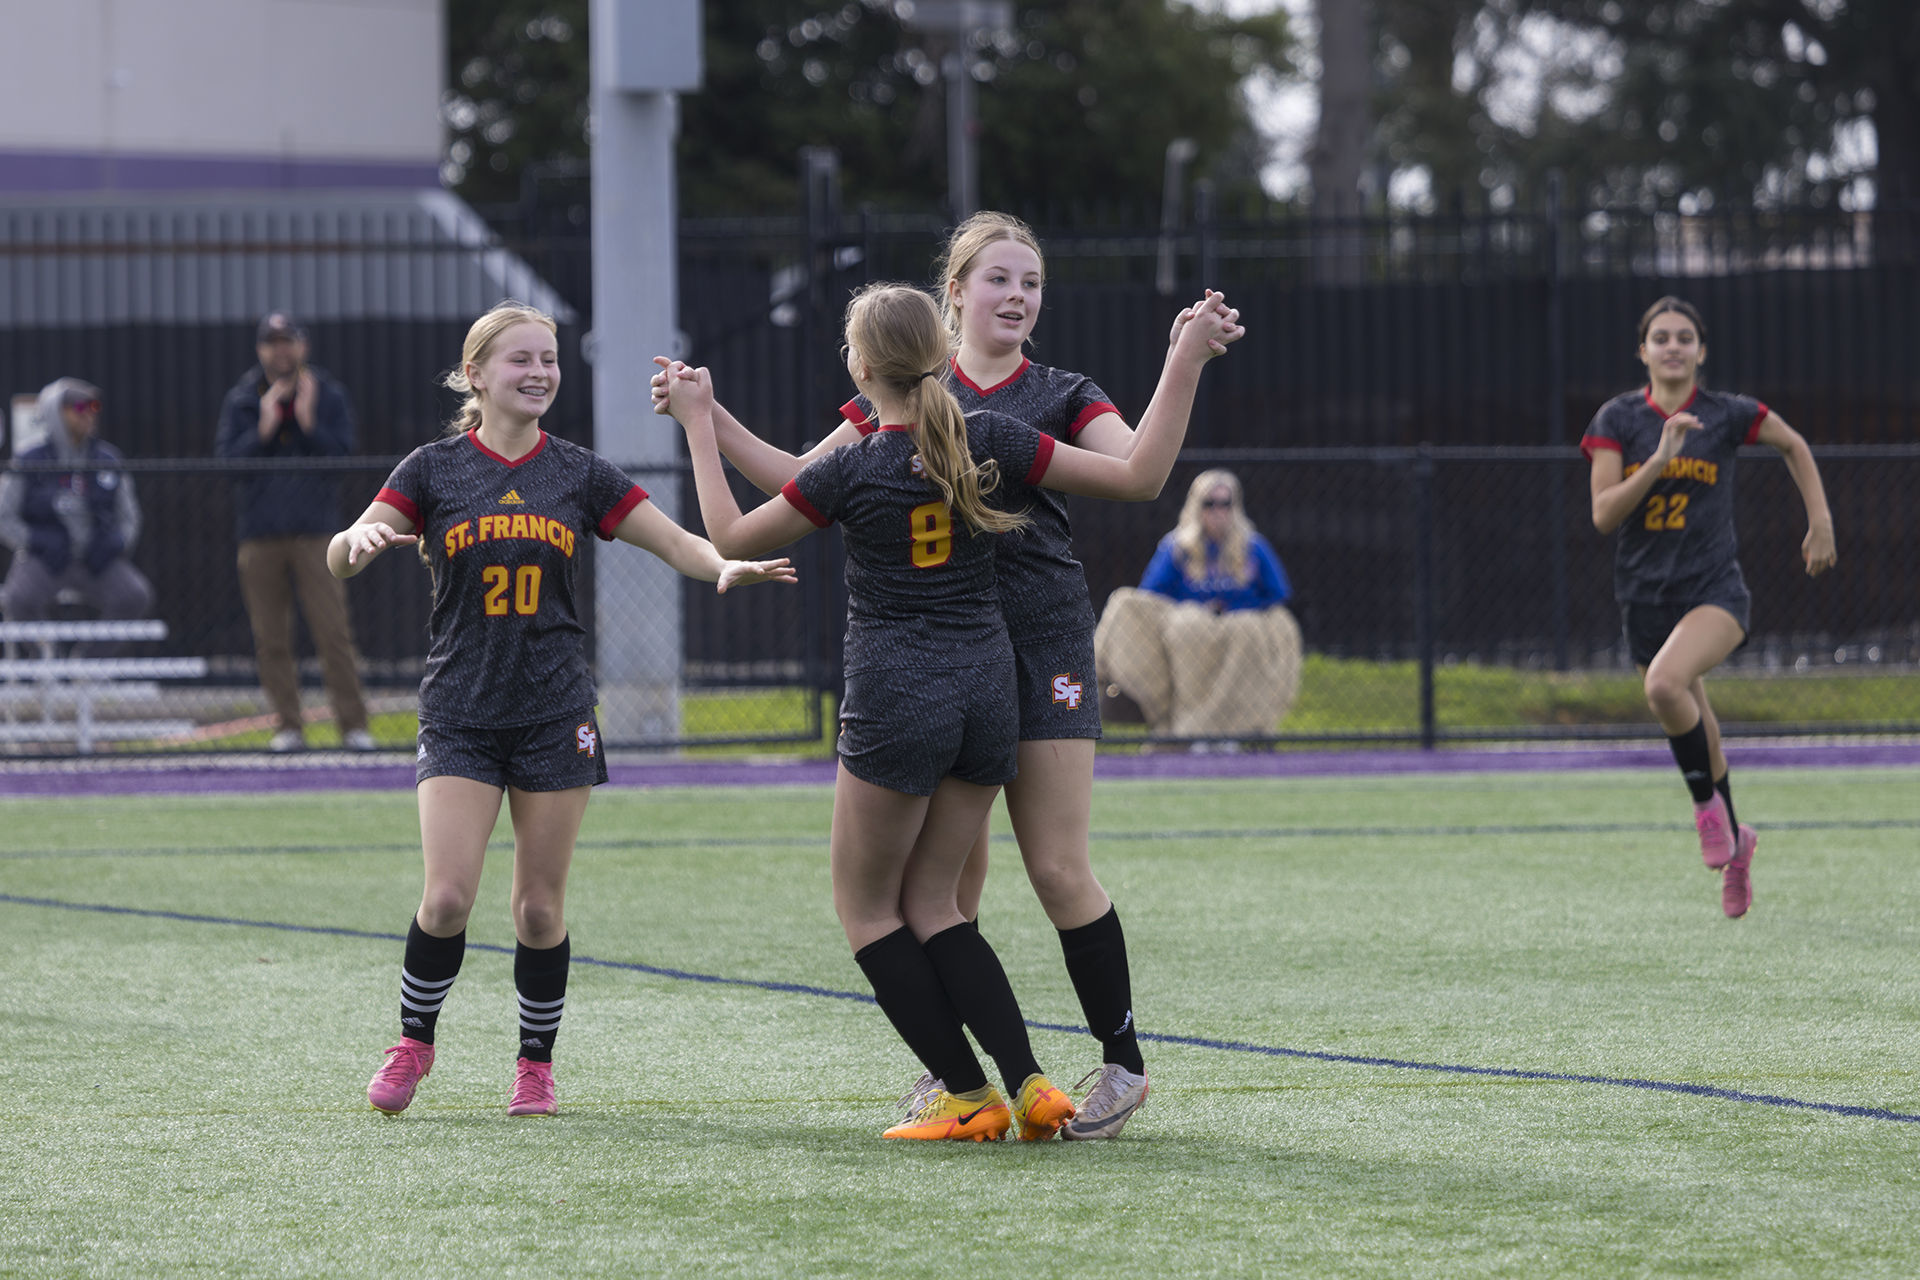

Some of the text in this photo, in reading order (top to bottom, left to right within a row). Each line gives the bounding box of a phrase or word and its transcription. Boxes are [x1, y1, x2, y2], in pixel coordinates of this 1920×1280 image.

[1645, 493, 1689, 531] 22
[445, 514, 575, 561] ST. FRANCIS
[908, 499, 953, 569] 8
[482, 564, 542, 616] 20
[1051, 672, 1082, 709] SF
[576, 721, 597, 758] SF
